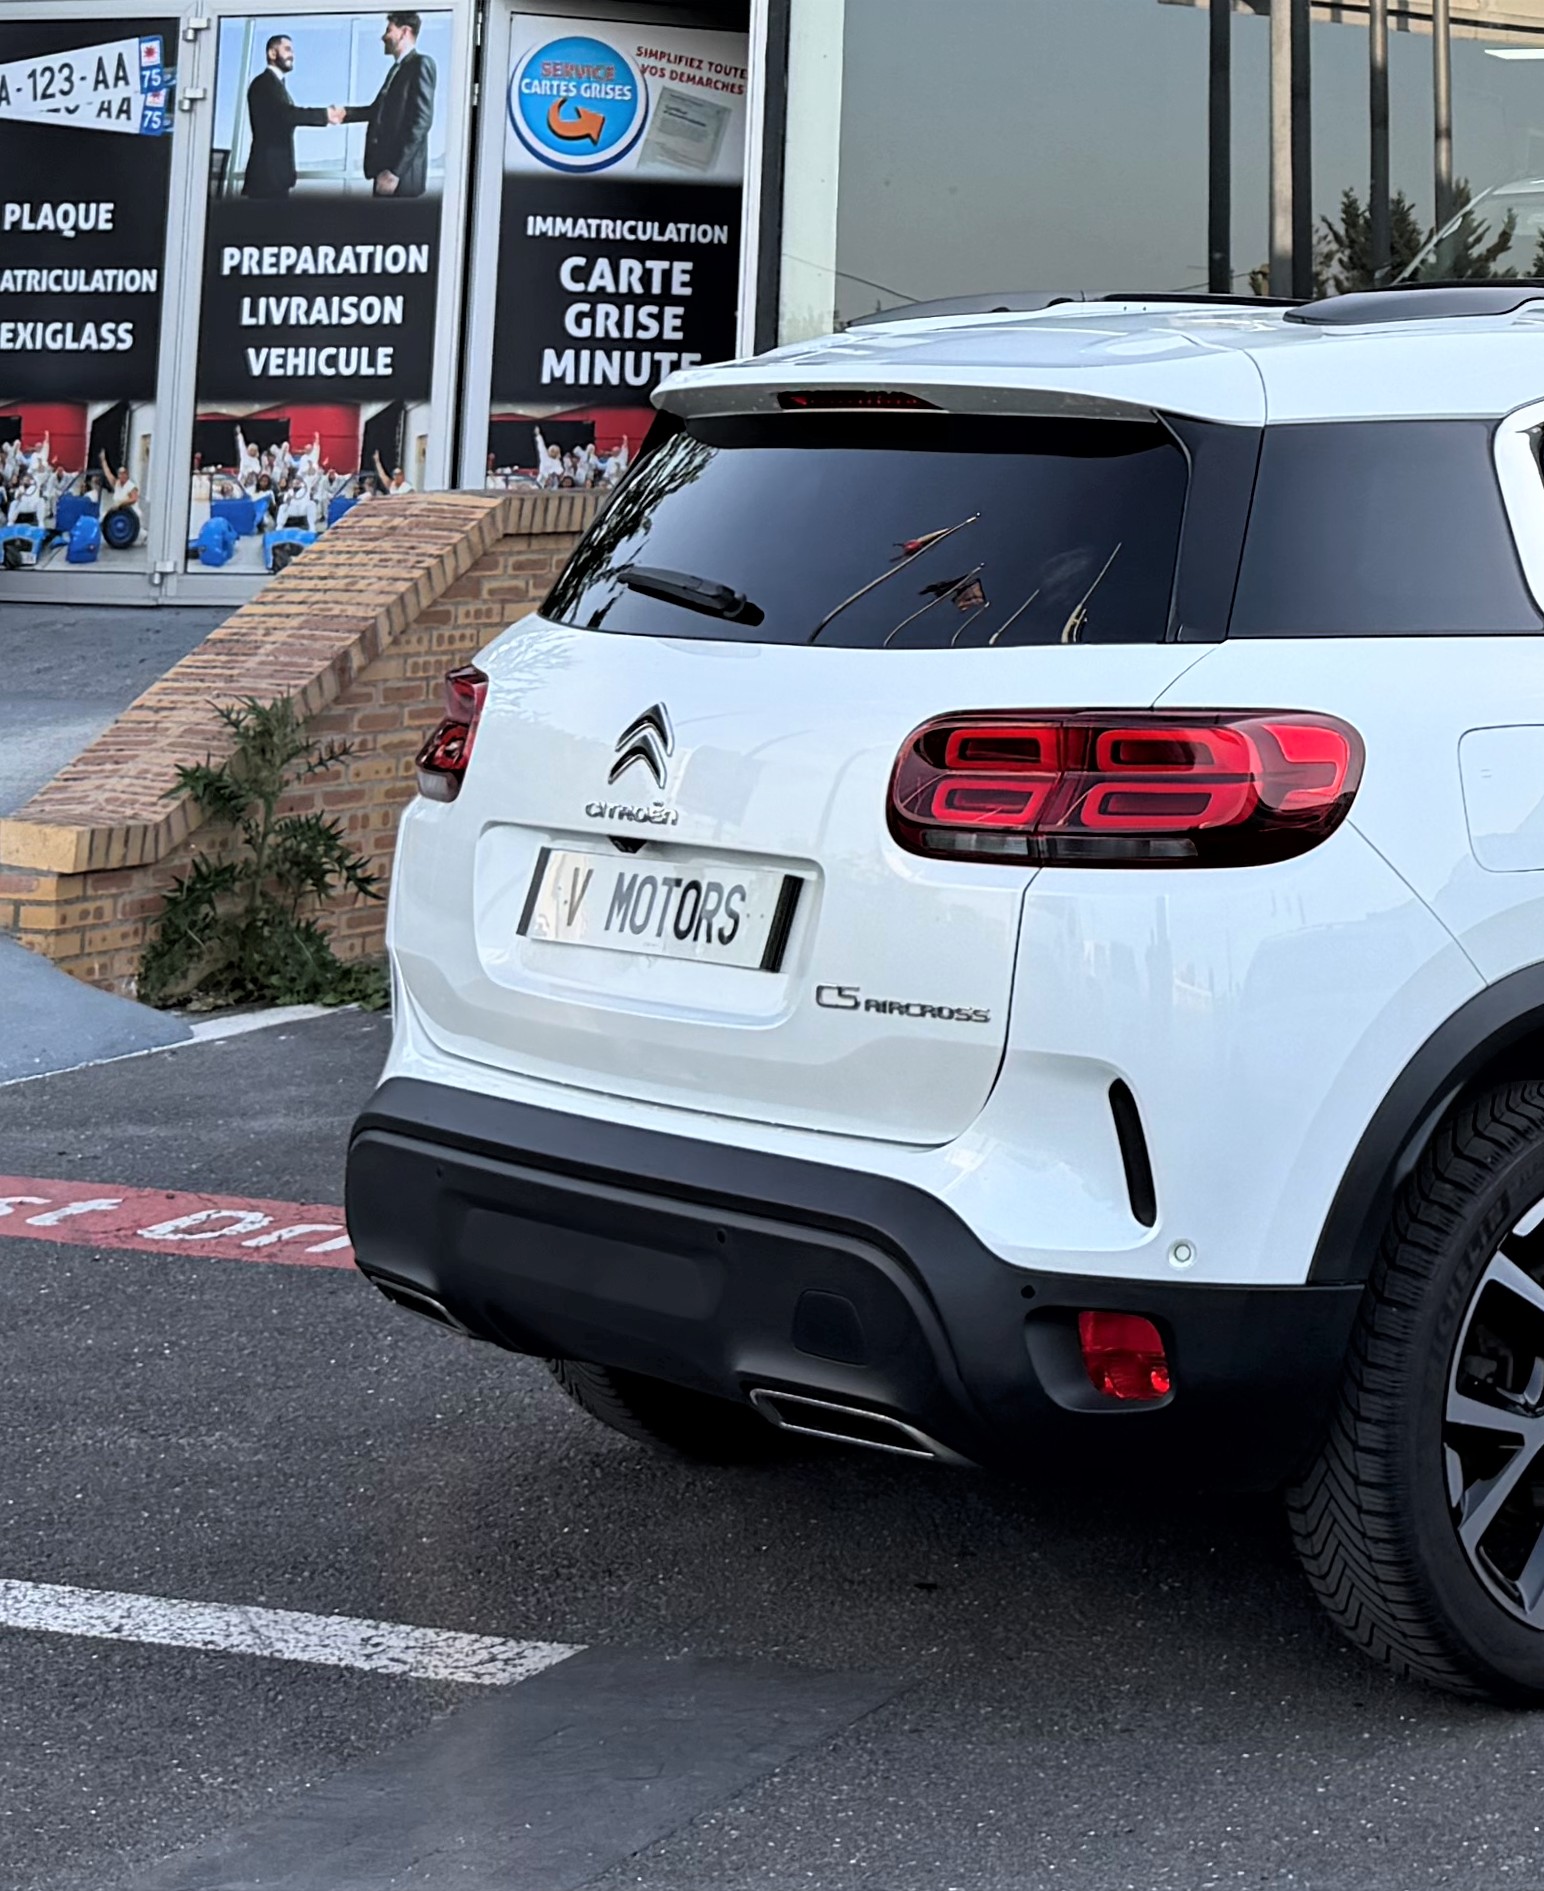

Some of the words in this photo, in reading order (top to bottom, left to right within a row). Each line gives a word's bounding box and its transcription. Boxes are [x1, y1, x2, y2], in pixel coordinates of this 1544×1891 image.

[541, 60, 616, 82] SERVICE
[635, 46, 704, 70] SIMPLIFIEZ
[708, 60, 748, 81] TOUTE
[142, 69, 161, 88] 75
[521, 77, 577, 98] CARTES
[581, 83, 633, 101] GRISES
[640, 63, 667, 79] VOS
[669, 67, 745, 95] DEMARCHES
[144, 111, 162, 129] 75
[4, 203, 114, 238] PLAQUE
[527, 215, 728, 244] IMMATRICULATION
[222, 244, 429, 275] PREPARATION
[0, 269, 157, 292] ATRICULATION
[560, 256, 693, 295] CARTE
[241, 296, 404, 325] LIVRAISON
[564, 303, 685, 340] GRISE
[0, 322, 134, 350] EXIGLASS
[247, 347, 394, 376] VEHICULE
[566, 867, 594, 926] V
[604, 872, 746, 945] MOTORS
[816, 984, 861, 1010] C5
[864, 998, 991, 1023] AIRCROSS
